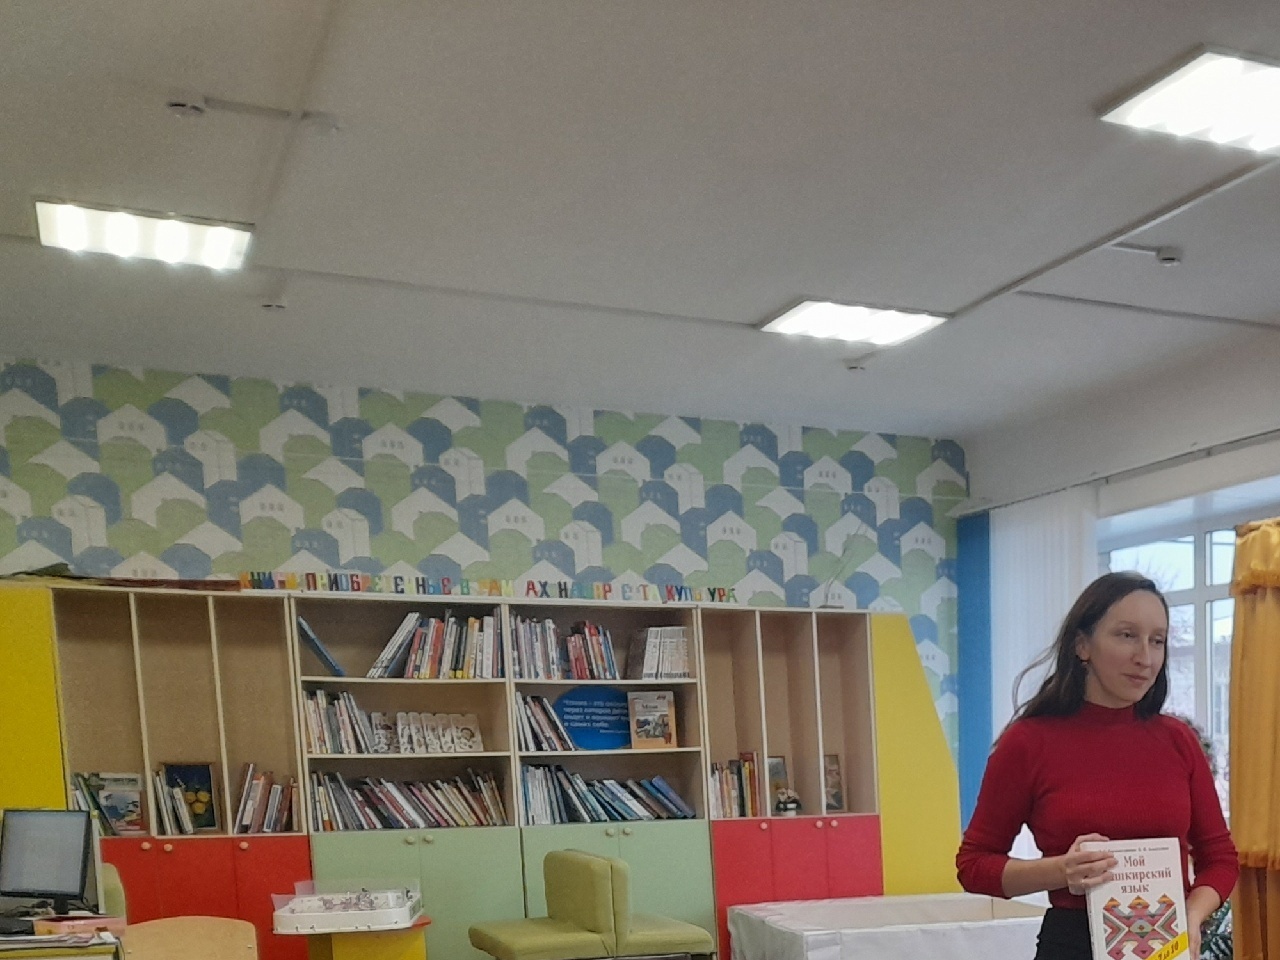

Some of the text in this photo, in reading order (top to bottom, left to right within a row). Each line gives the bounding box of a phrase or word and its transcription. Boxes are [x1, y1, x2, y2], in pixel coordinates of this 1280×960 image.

[478, 578, 551, 598] РАМАХ
[665, 584, 738, 603] КУЛЬУРА
[1123, 855, 1145, 868] Мой
[1111, 867, 1172, 883] шкирский
[1120, 884, 1150, 894] язык
